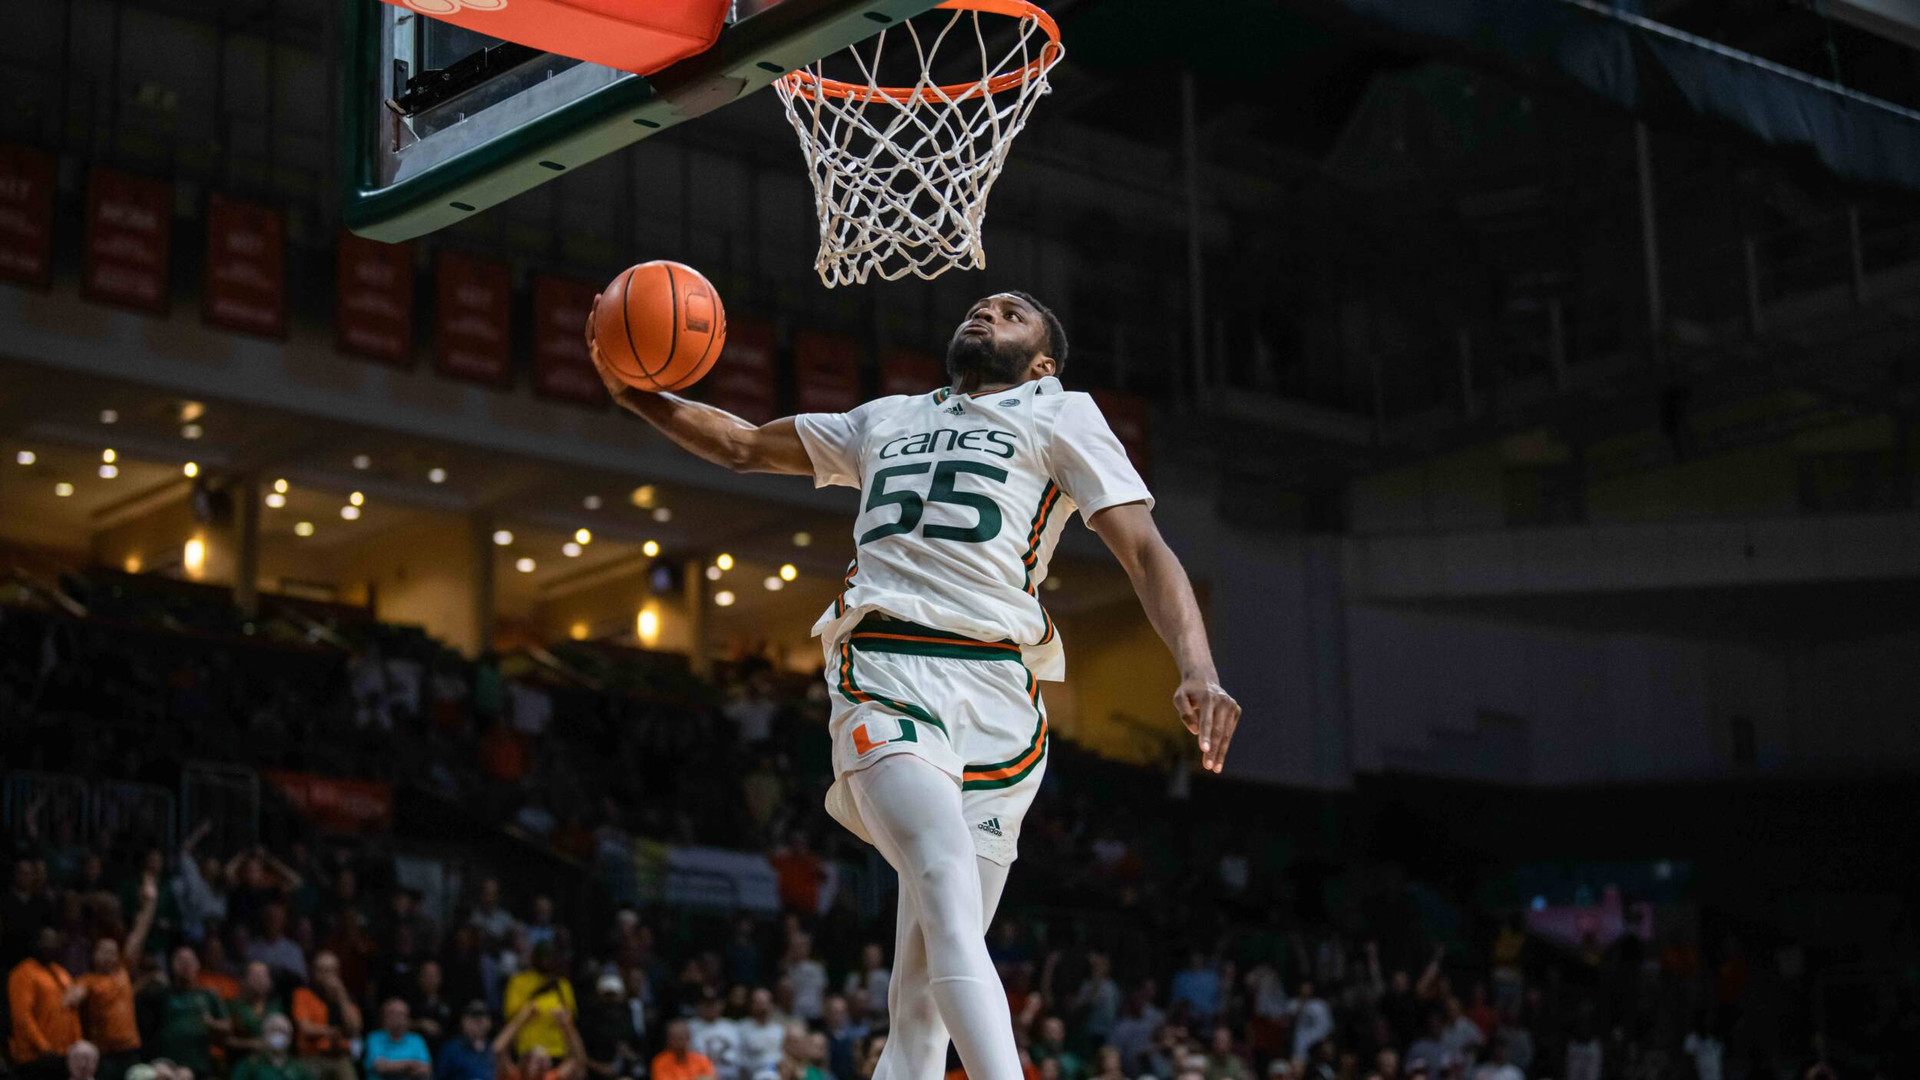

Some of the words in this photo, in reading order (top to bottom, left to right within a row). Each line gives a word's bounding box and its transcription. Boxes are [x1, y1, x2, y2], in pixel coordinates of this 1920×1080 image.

[859, 460, 1009, 546] 55
[852, 719, 918, 755] U
[977, 823, 1002, 836] adidas
